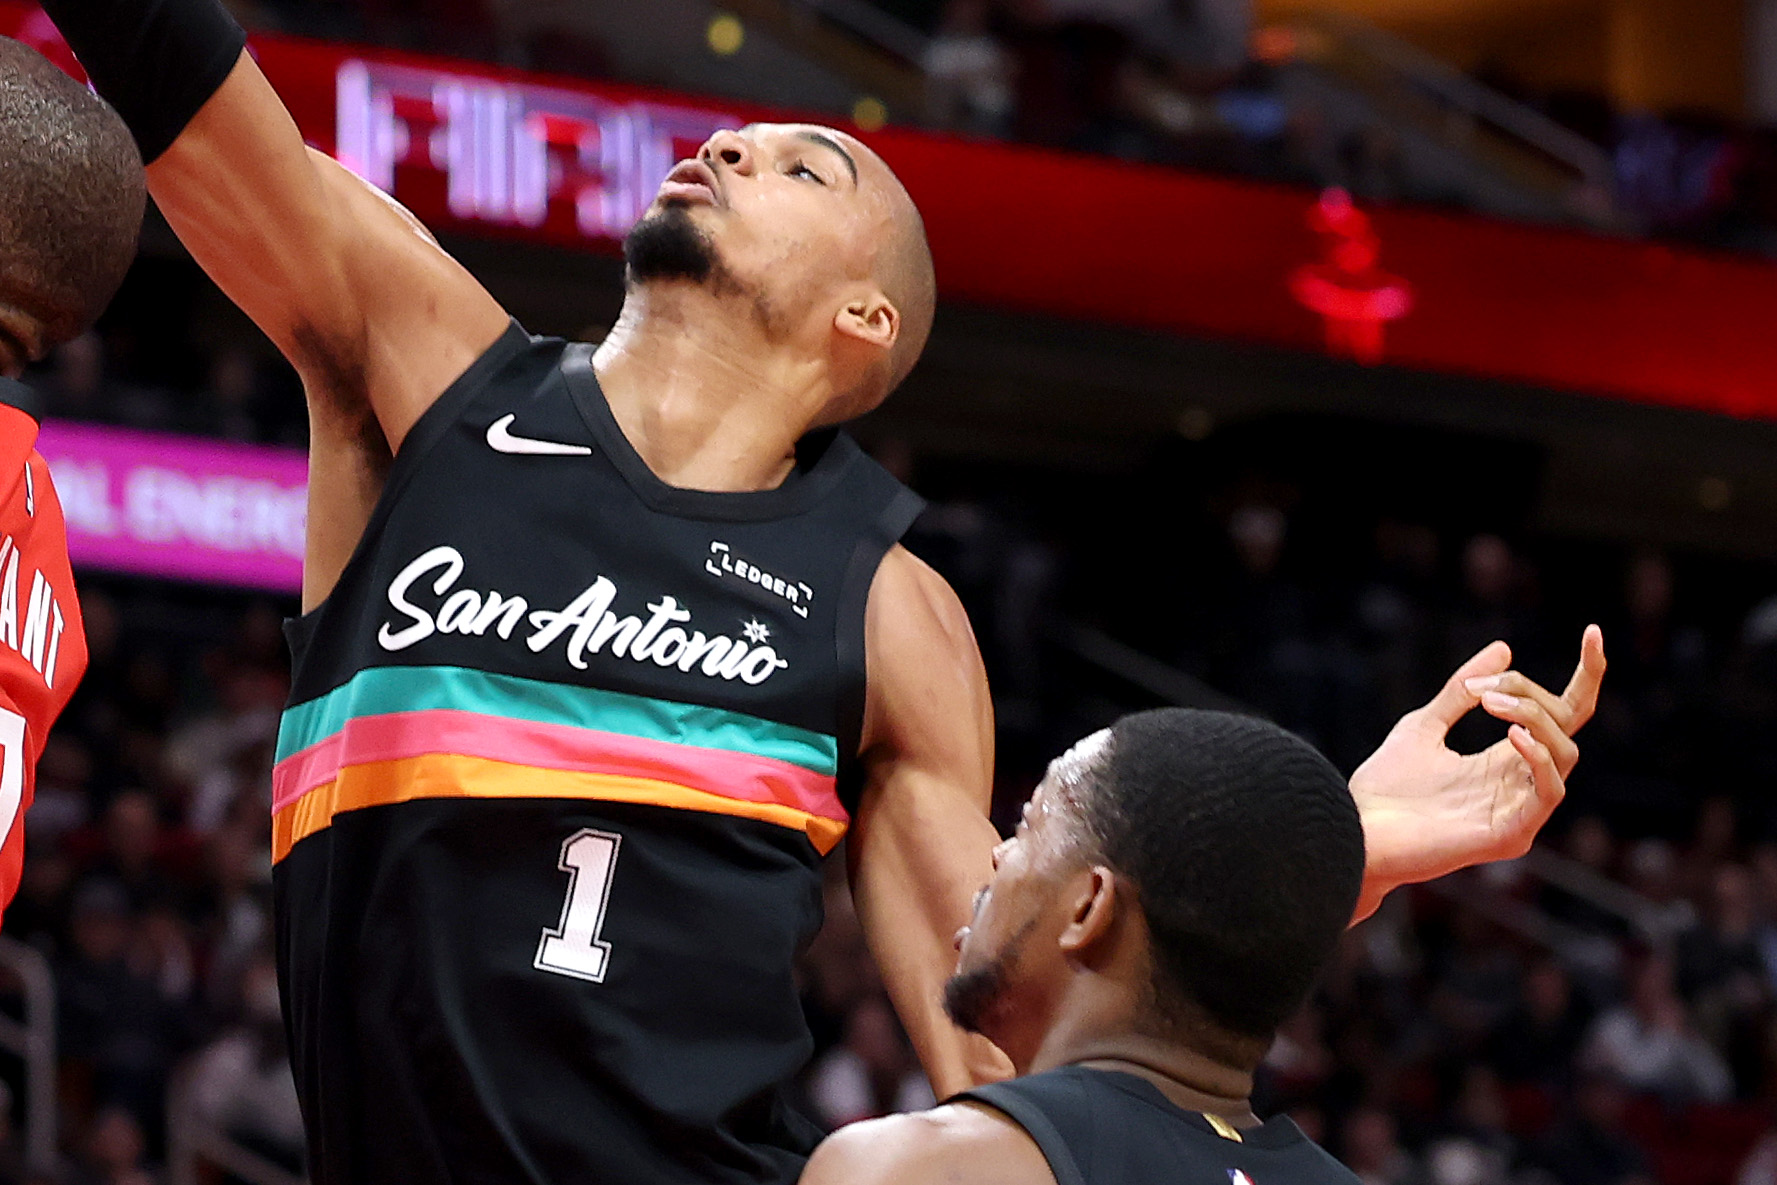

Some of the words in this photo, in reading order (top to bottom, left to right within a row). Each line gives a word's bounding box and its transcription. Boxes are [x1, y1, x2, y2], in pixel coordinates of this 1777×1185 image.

[377, 545, 528, 652] San
[526, 574, 788, 686] Antonio
[533, 827, 622, 984] 1
